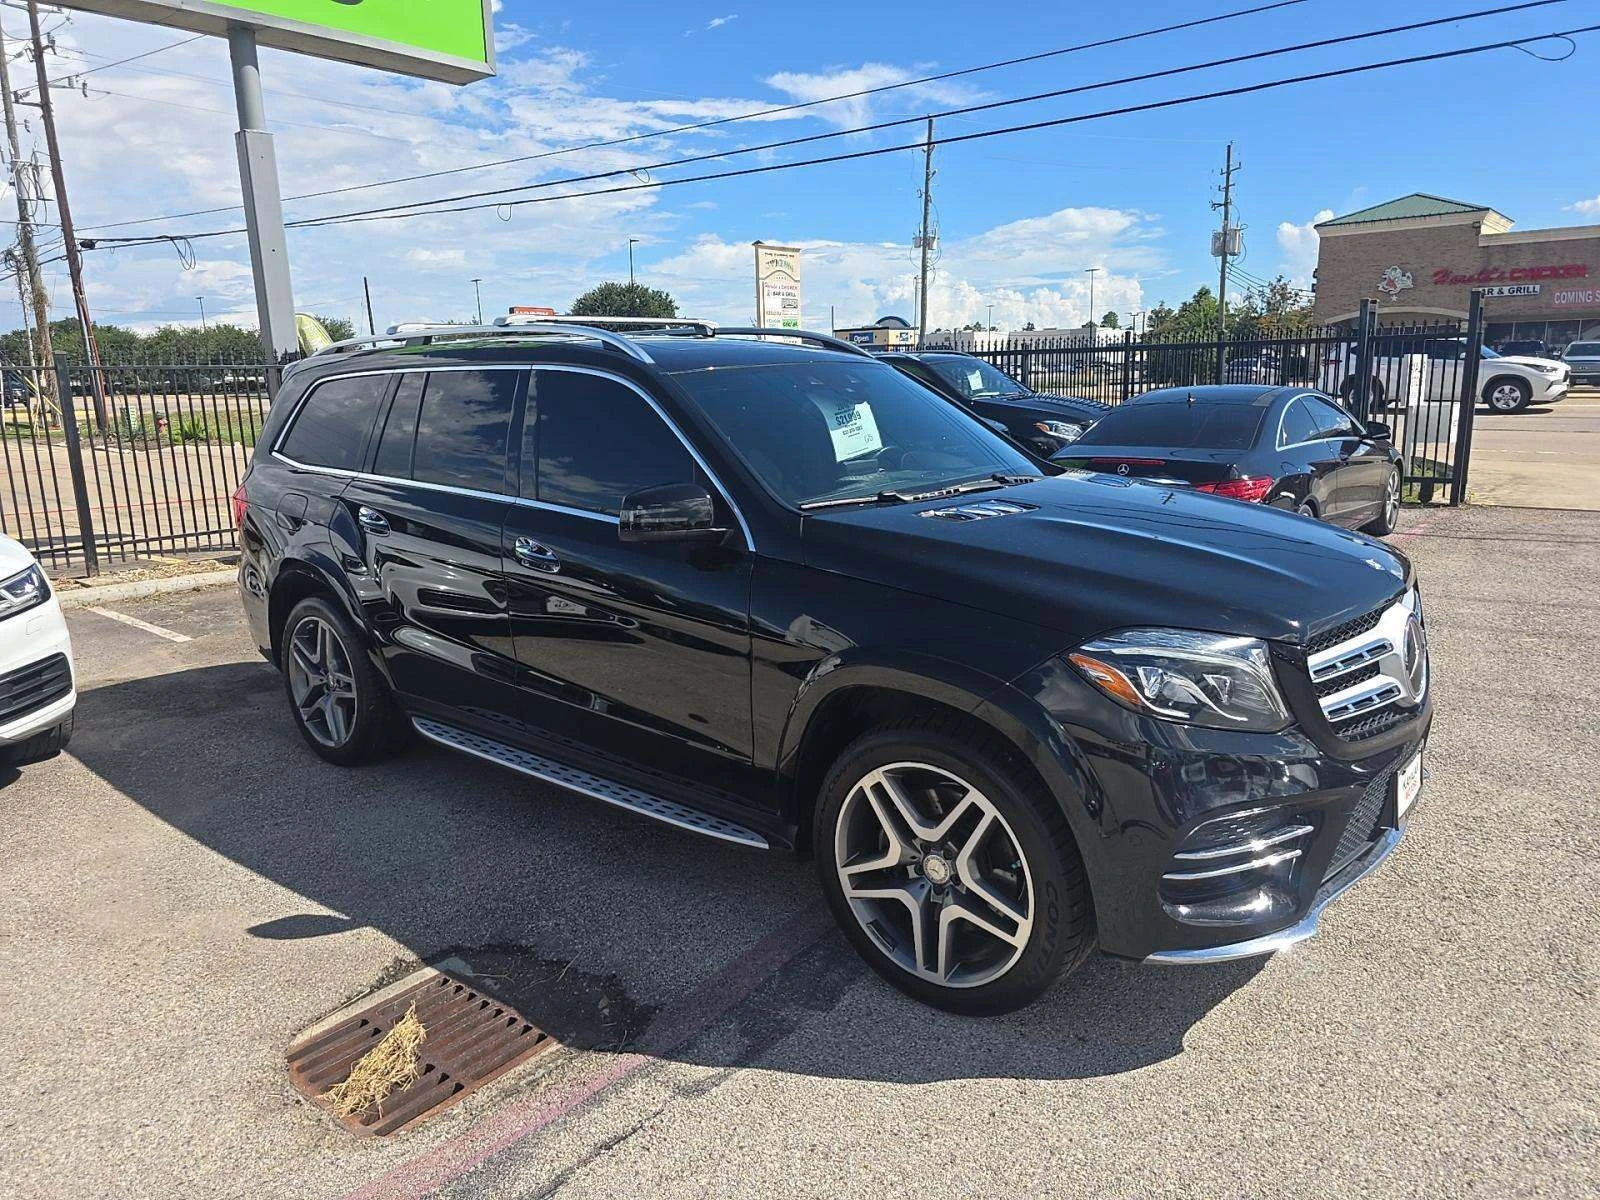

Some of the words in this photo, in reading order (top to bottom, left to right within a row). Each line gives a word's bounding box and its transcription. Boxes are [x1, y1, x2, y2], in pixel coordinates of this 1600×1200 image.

[1497, 287, 1505, 295] &
[1508, 286, 1539, 294] GRILL
[1554, 290, 1593, 305] COMING
[854, 335, 870, 344] Open
